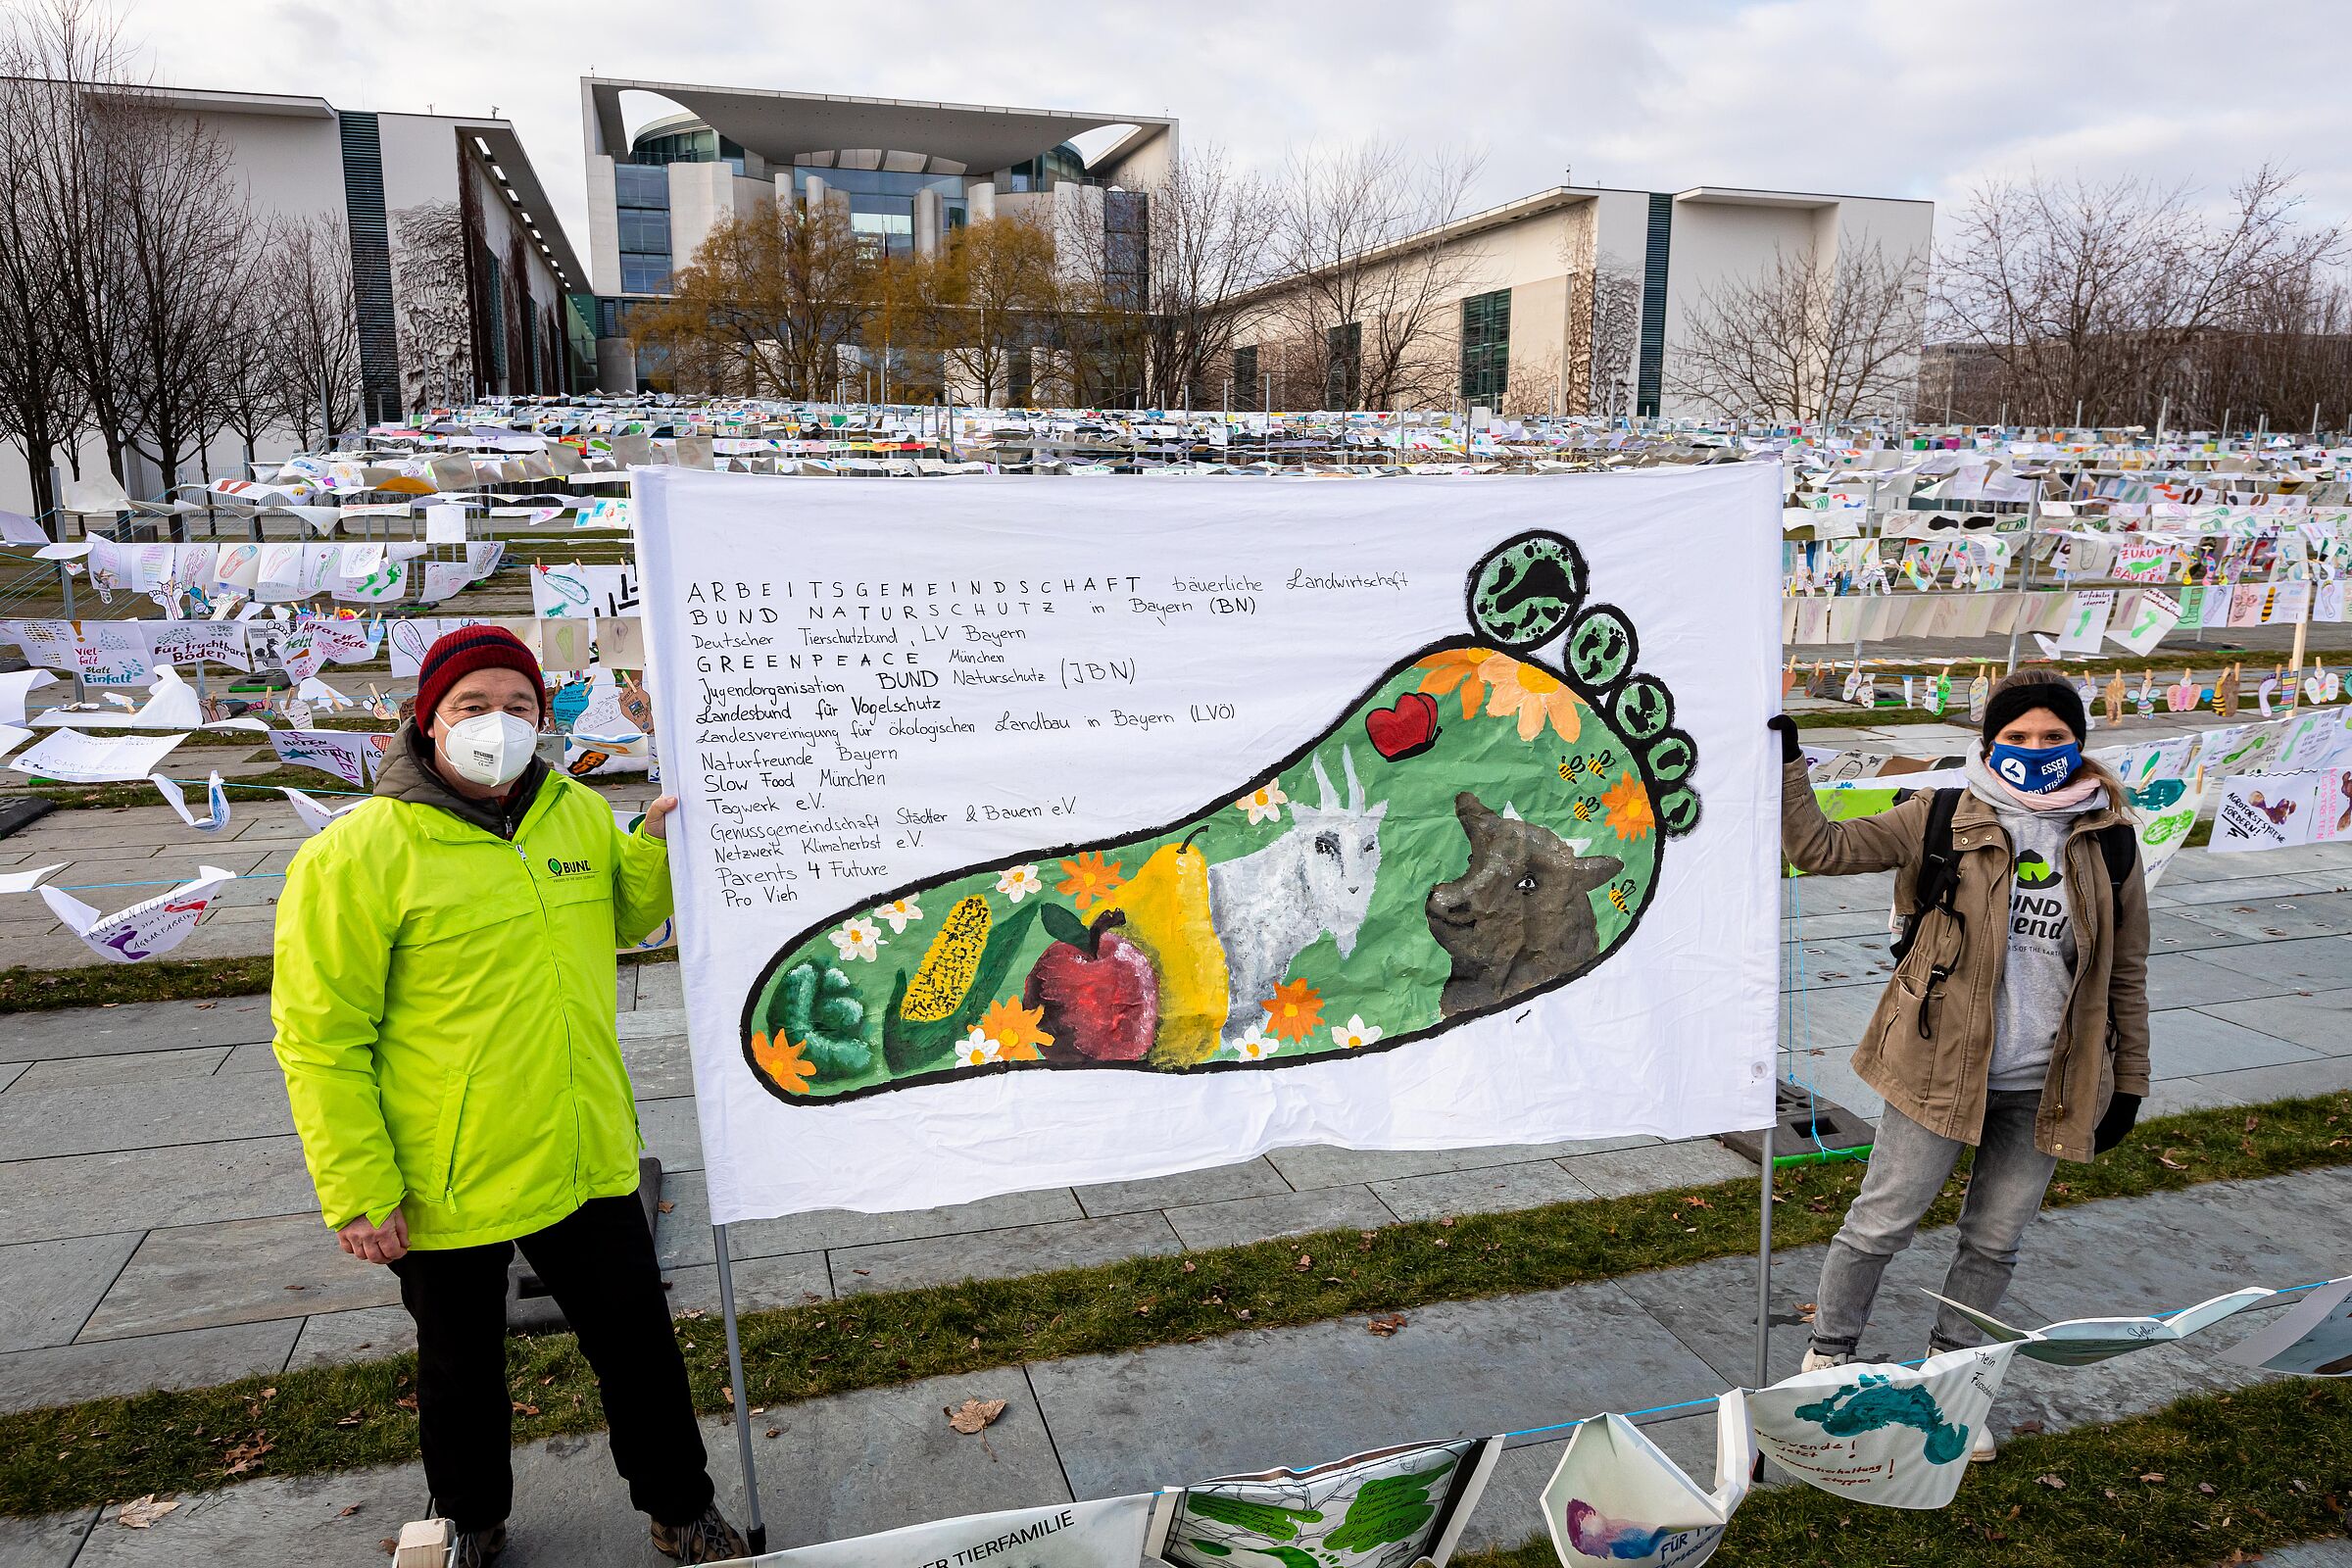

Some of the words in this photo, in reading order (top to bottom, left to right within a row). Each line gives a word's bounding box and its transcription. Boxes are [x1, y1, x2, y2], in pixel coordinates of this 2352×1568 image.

[2121, 545, 2176, 561] ZUKUNFT
[2113, 566, 2165, 582] BAUERN
[687, 576, 1143, 605] ARBEITSGEMEINDSCHAFT
[1172, 575, 1263, 592] bäuerliche
[1287, 568, 1408, 590] Landwirtschaft
[690, 608, 777, 624] BUND
[809, 603, 1054, 620] NATURSCHUTZ
[1089, 601, 1106, 614] in
[1129, 598, 1193, 626] Bayern
[1210, 596, 1255, 614] (BN)
[153, 645, 180, 656] Für
[184, 639, 246, 659] fruchtbare
[691, 632, 773, 649] Deutscher
[798, 626, 898, 646] Tierschutzbund
[921, 625, 949, 642] LV
[961, 625, 1025, 647] Bayern
[74, 647, 103, 658] Viel-
[78, 655, 99, 666] falt
[172, 649, 226, 664] Böden
[698, 653, 918, 672] GREENPEACE
[949, 649, 1004, 663] München
[83, 673, 132, 685] Einfalt
[84, 665, 111, 675] statt
[699, 675, 845, 707] Jugendorganisation
[875, 670, 939, 689] BUND
[954, 667, 1046, 685] Naturschutz
[1061, 658, 1135, 689] (JBN)
[696, 702, 792, 724] Landesbund
[815, 699, 838, 720] für
[851, 695, 941, 726] Vogelschutz
[696, 726, 841, 747] Landesvereinigung
[851, 720, 872, 738] für
[889, 716, 975, 742] ökologischen
[995, 710, 1070, 731] Landbau
[1083, 715, 1101, 728] in
[1110, 710, 1174, 731] Bayern
[1191, 704, 1234, 722] (LVÖ)
[701, 751, 814, 772] Naturfreunde
[836, 747, 897, 769] Bayern
[2040, 756, 2069, 776] ESSEN
[705, 775, 748, 792] Slow
[760, 772, 795, 788] Food
[820, 768, 885, 787] München
[706, 796, 780, 824] Tagwerk
[797, 793, 824, 810] e.V.
[710, 814, 881, 846] Genussgemeindschaft
[896, 808, 948, 824] Städter
[966, 805, 978, 822] &
[982, 806, 1042, 820] Bauern
[1052, 797, 1076, 815] e.V.
[714, 841, 785, 863] Netzwerk
[802, 834, 881, 855] Klimaherbst
[897, 830, 923, 848] e.V.
[715, 862, 797, 887] Parents
[808, 861, 820, 879] 4
[828, 860, 888, 877] Future
[721, 889, 752, 906] Pro
[763, 884, 797, 903] Vieh
[1975, 1351, 1996, 1368] Mein
[953, 1509, 1076, 1566] TIERFAMILIE
[1660, 1533, 1689, 1561] FÜR
